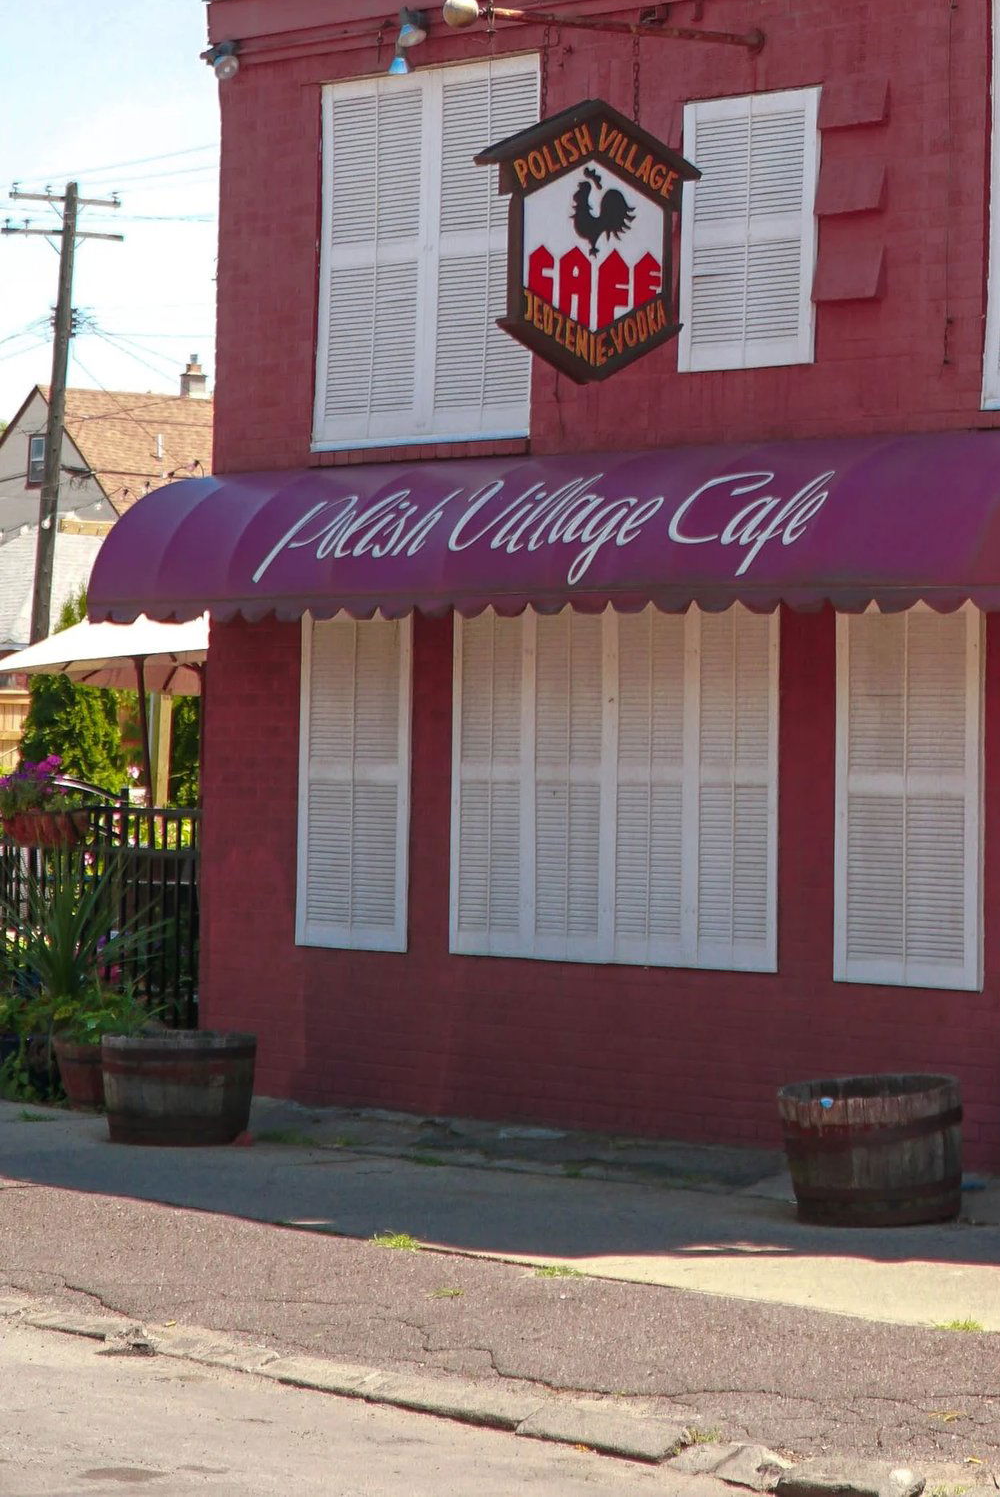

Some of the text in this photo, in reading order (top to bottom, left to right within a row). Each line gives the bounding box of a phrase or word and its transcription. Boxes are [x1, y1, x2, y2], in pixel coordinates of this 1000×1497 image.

[513, 122, 679, 200] POLISH VILLAGE
[528, 245, 662, 330] CAFE
[253, 487, 464, 583] Polish
[448, 473, 665, 585] Village
